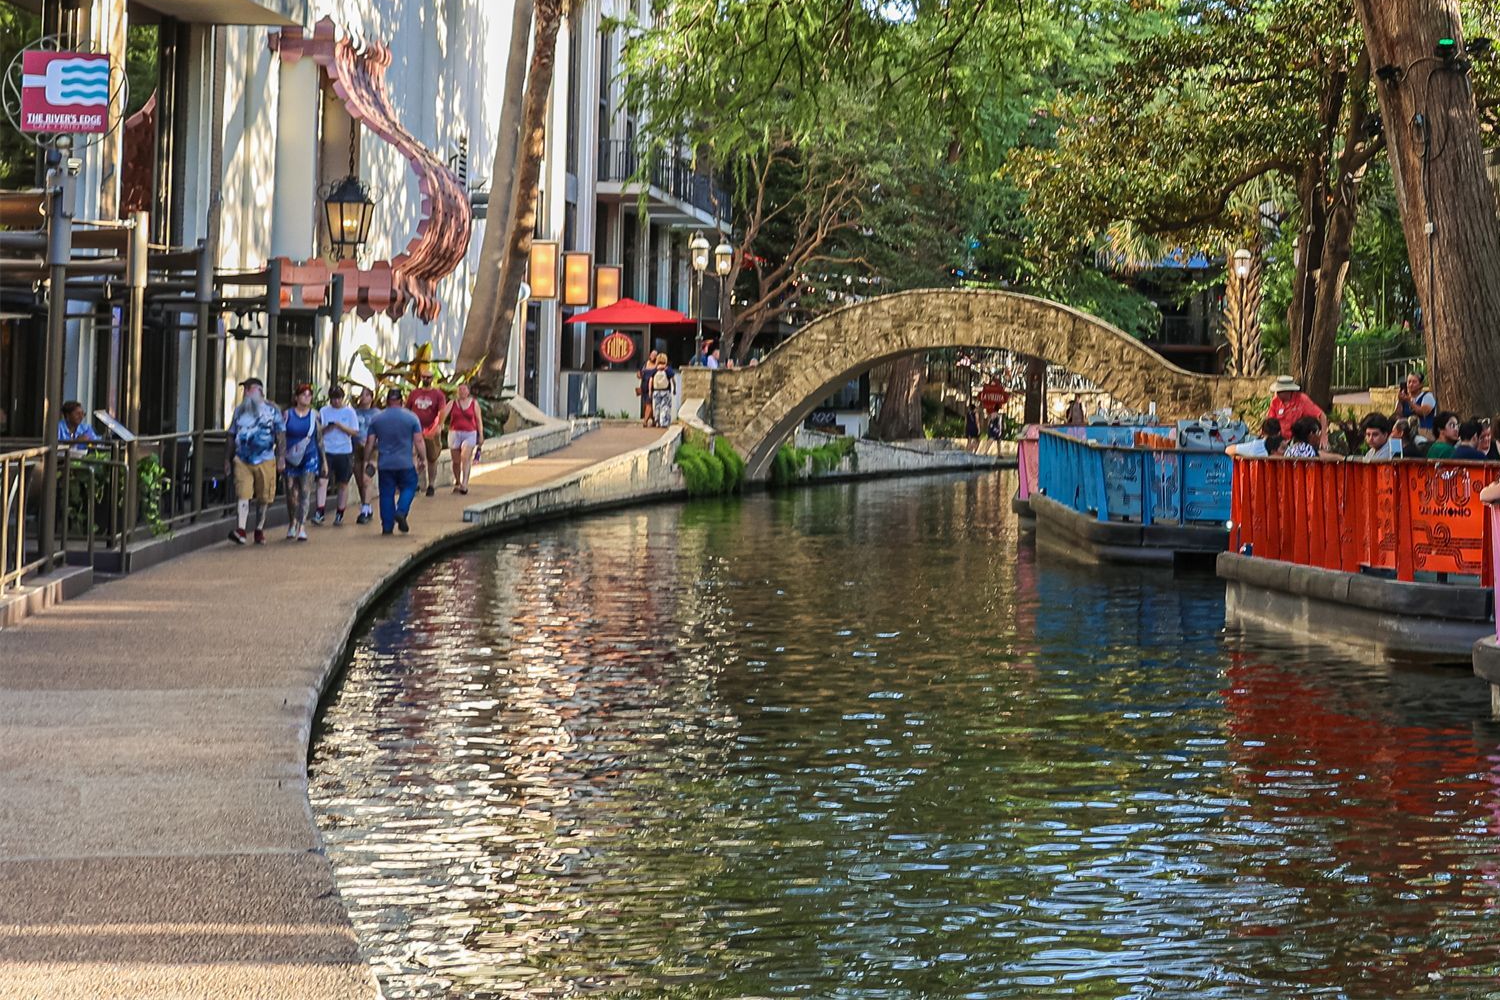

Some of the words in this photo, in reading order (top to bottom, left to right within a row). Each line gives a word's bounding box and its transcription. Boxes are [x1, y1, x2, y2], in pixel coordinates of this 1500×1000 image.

[27, 113, 44, 124] THE
[45, 114, 77, 125] RIVER'S
[79, 115, 102, 126] EDGE
[1418, 464, 1470, 507] 300
[1433, 506, 1472, 518] ANTONIO
